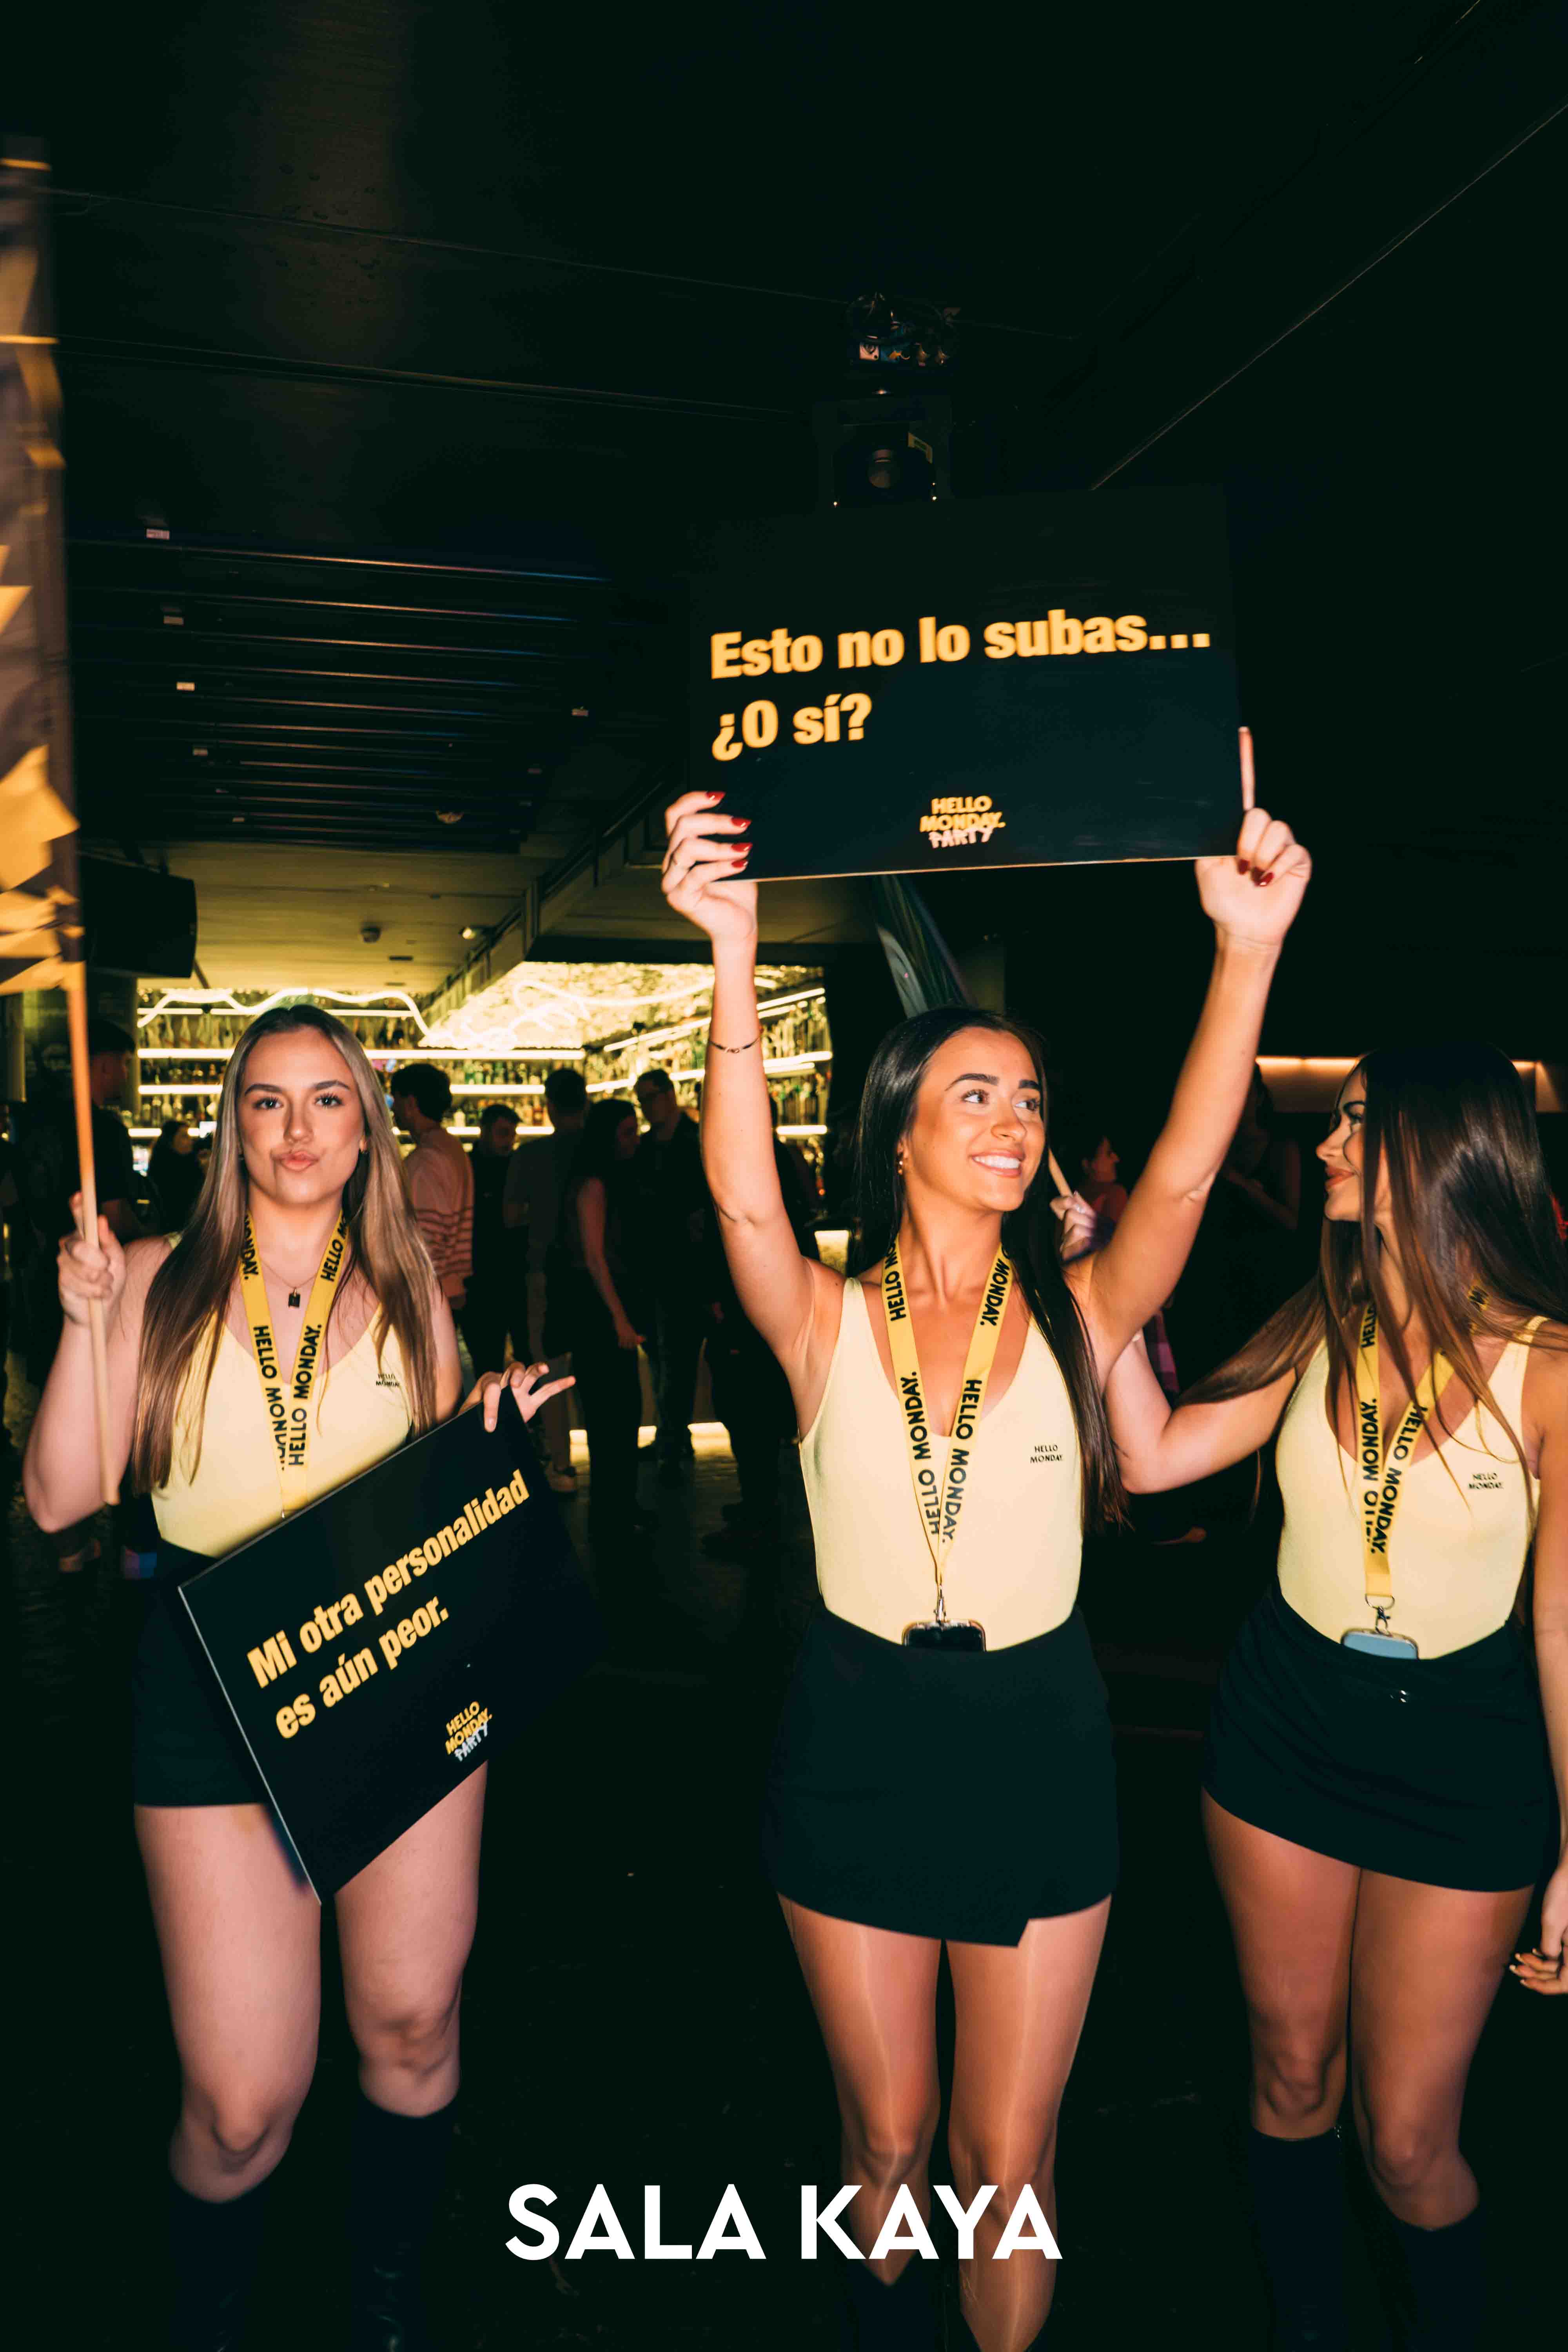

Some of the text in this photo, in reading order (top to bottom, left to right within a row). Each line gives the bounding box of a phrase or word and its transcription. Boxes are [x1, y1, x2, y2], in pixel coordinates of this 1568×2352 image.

[710, 609, 1210, 680] Esto no lo subas...
[711, 692, 873, 762] ¿O sí?
[928, 826, 995, 849] PARTY
[931, 796, 993, 815] HELLO
[320, 1239, 343, 1282] HELLO
[980, 1258, 1010, 1326] MONDAY.
[885, 1271, 907, 1321] HELLO
[253, 1325, 277, 1379] HELLO
[288, 1324, 322, 1466] HELLO MONDAY.
[900, 1371, 940, 1535] HELLO MONDAY.
[942, 1379, 982, 1543] HELLO MONDAY.
[1034, 1444, 1058, 1452] HELLO
[1360, 1398, 1379, 1481] MONDAY.
[1370, 1467, 1402, 1553] MONDAY.
[247, 1468, 530, 1689] Mi otra personalidad
[276, 1595, 449, 1739] es aún peor.
[446, 1701, 480, 1736] HELLO
[454, 1721, 488, 1762] PARTY
